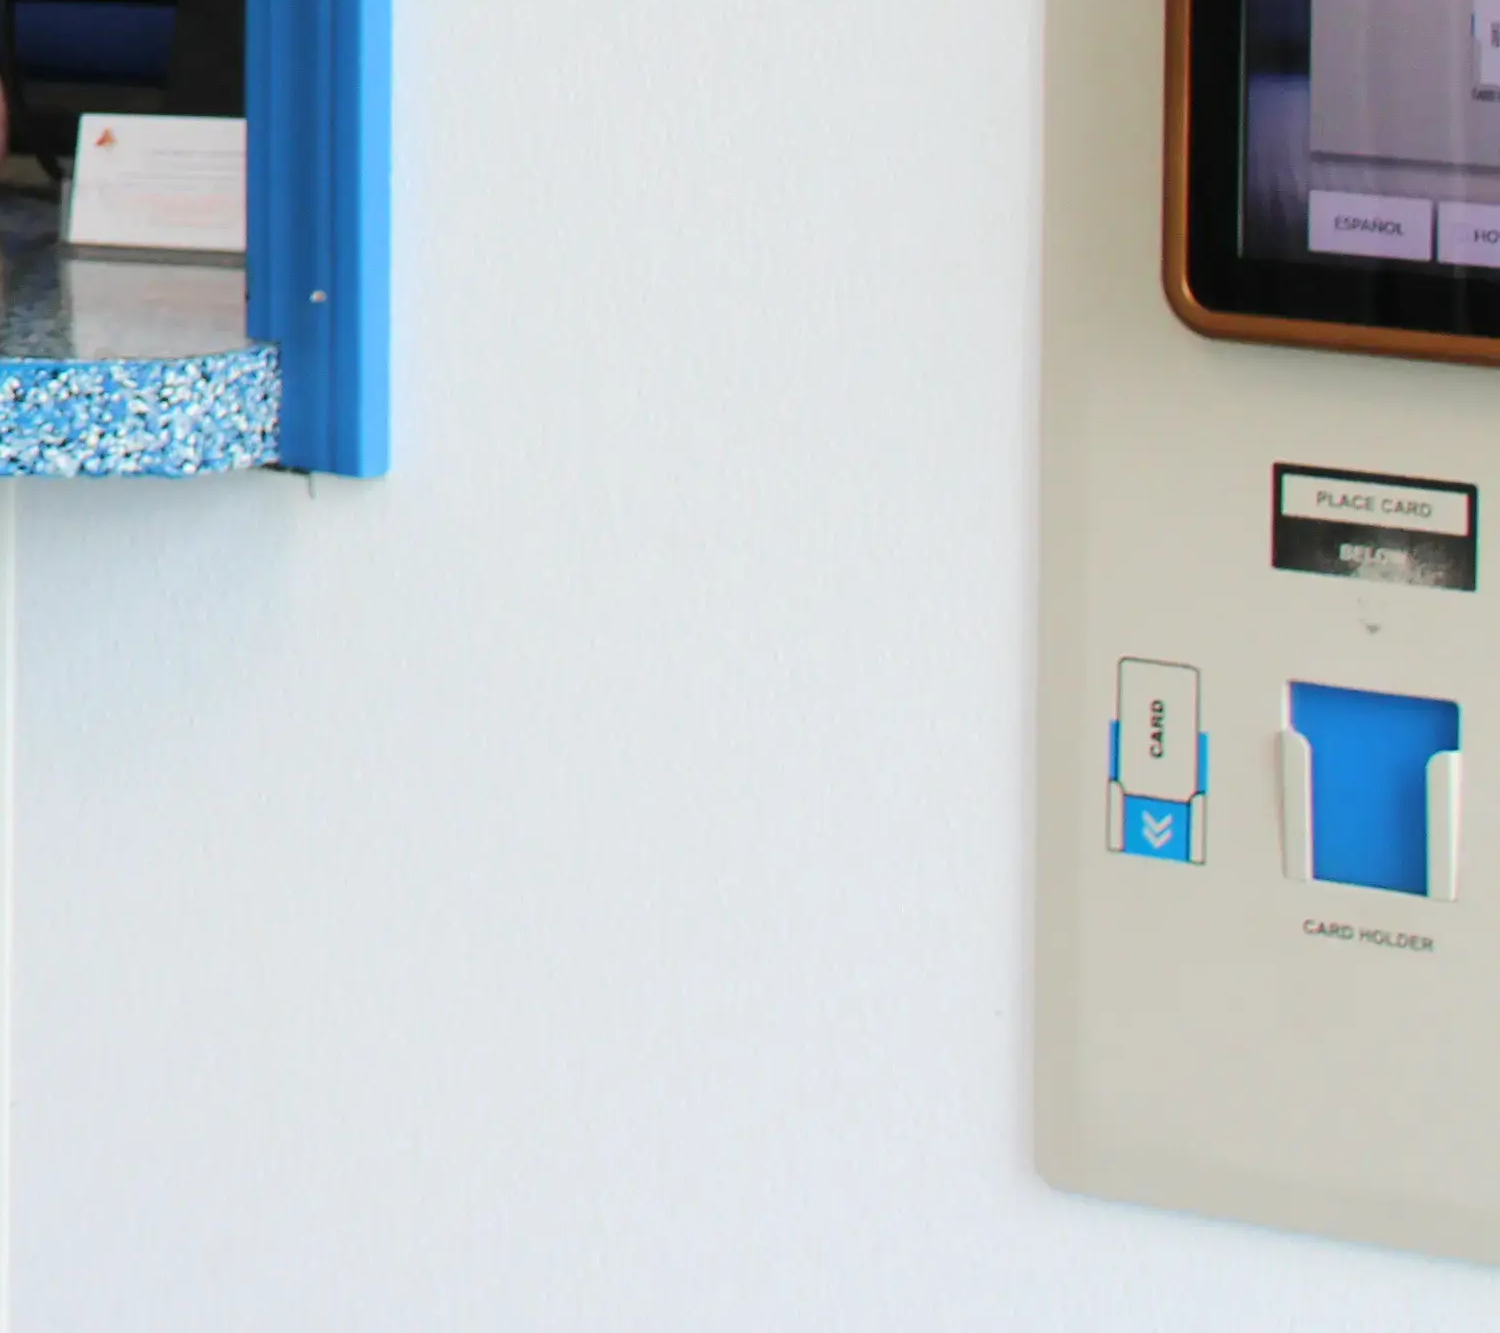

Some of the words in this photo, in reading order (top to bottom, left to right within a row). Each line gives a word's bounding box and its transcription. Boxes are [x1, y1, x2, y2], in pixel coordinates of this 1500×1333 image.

[1316, 491, 1375, 512] PLACE
[1381, 498, 1432, 519] CARD
[1150, 700, 1164, 758] CARD
[1302, 919, 1354, 941] CARD
[1358, 928, 1434, 953] HOLDER
